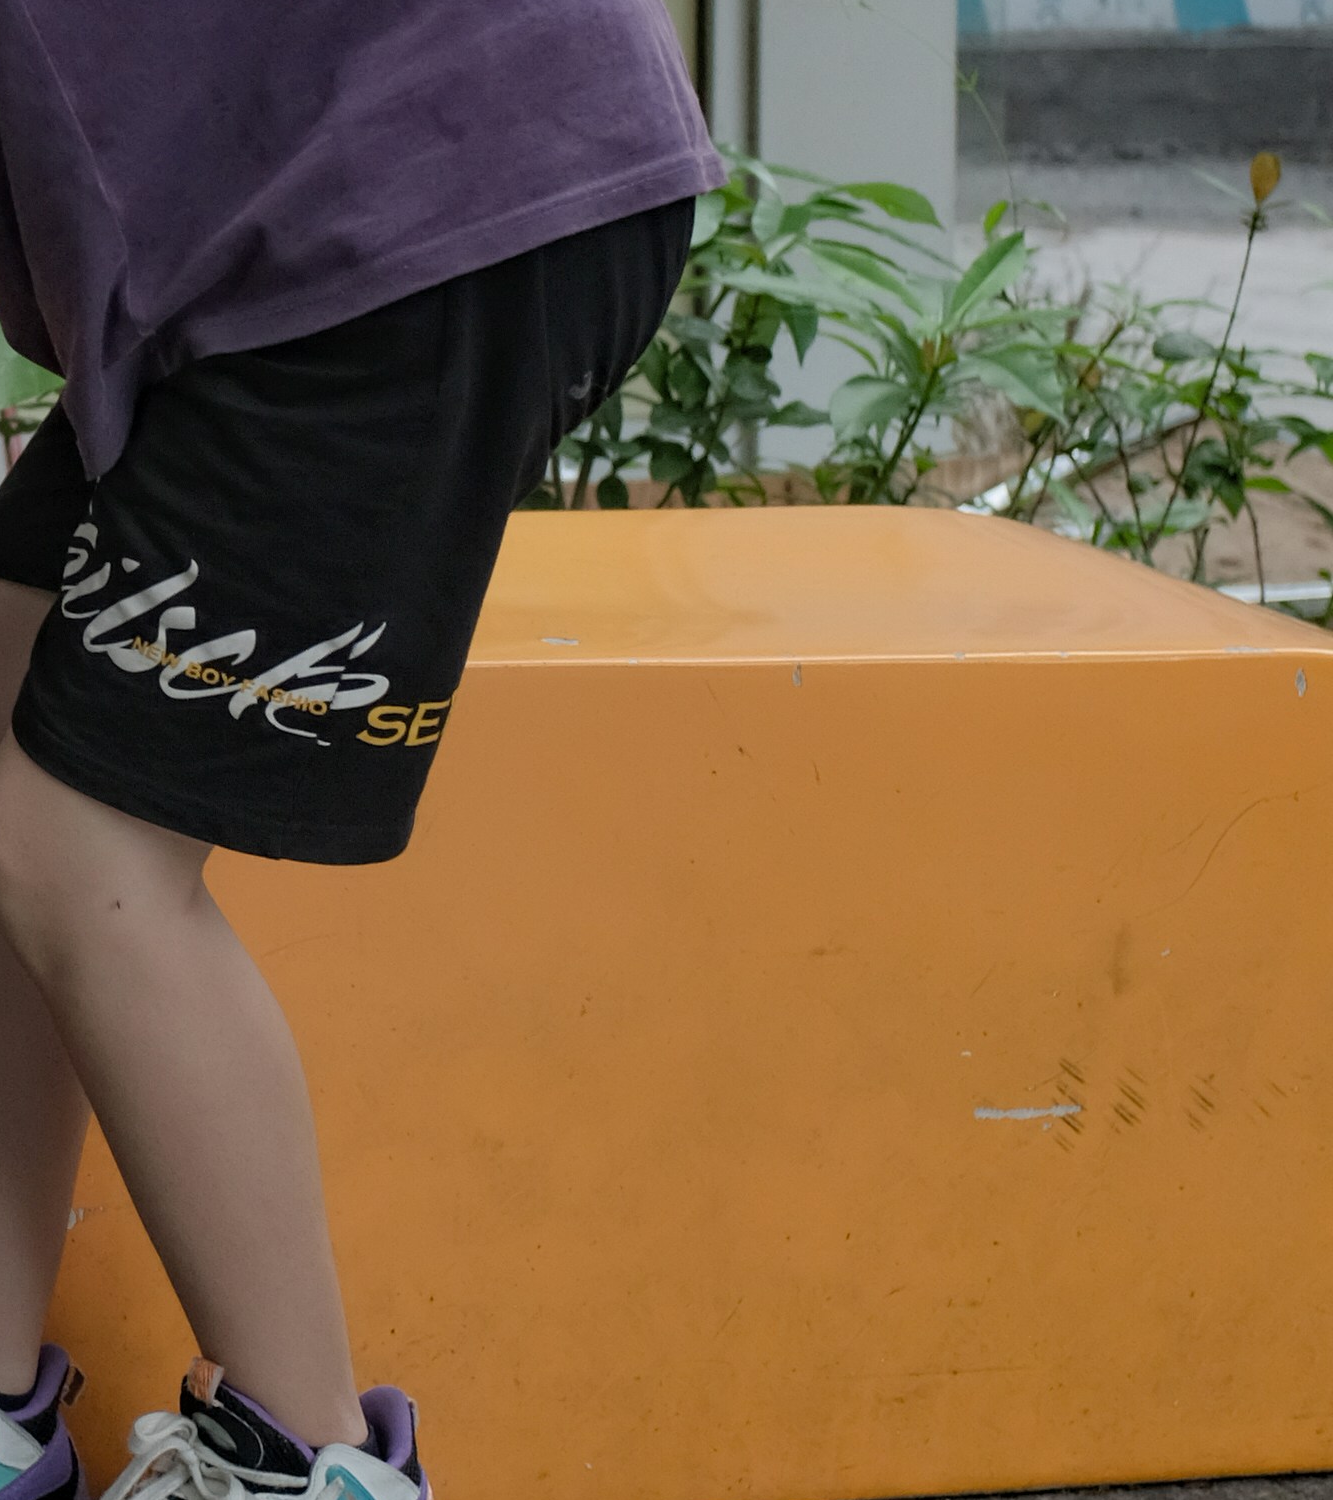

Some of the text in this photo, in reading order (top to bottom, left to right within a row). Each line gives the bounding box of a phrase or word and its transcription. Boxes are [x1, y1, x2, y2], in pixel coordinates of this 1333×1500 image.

[132, 635, 181, 669] NEW
[184, 661, 237, 692] BOY
[355, 697, 452, 748] SE
